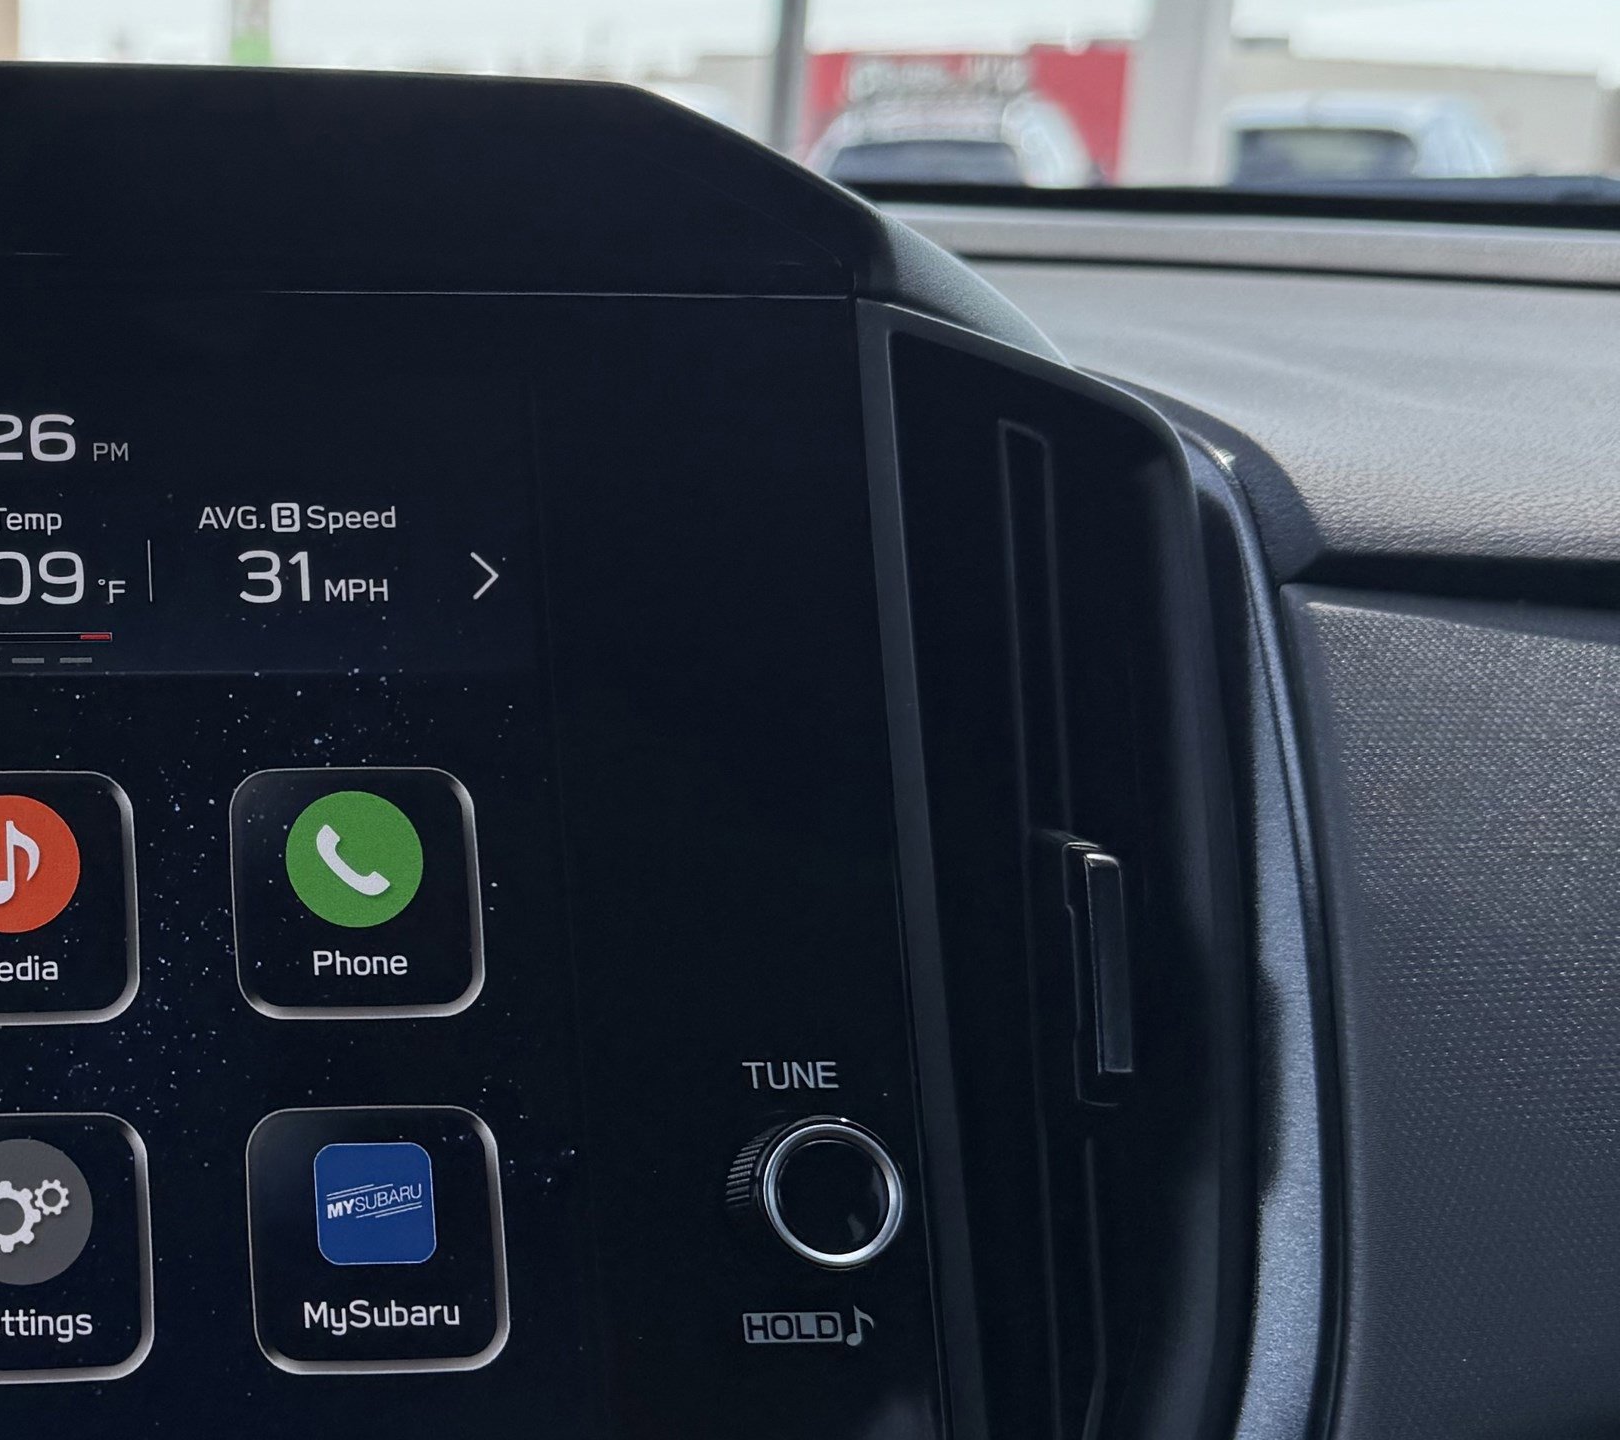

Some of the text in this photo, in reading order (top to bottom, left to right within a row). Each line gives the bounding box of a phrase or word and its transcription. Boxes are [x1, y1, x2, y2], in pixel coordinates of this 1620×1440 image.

[93, 442, 129, 462] PM
[198, 505, 266, 530] AVG.
[306, 505, 397, 535] Speed
[237, 549, 389, 604] 31 MPH
[312, 950, 408, 976] Phone
[741, 1061, 840, 1090] TUNE
[326, 1183, 422, 1219] MYSUBARU
[303, 1299, 460, 1336] MySubaru
[745, 1314, 839, 1341] HOLD
